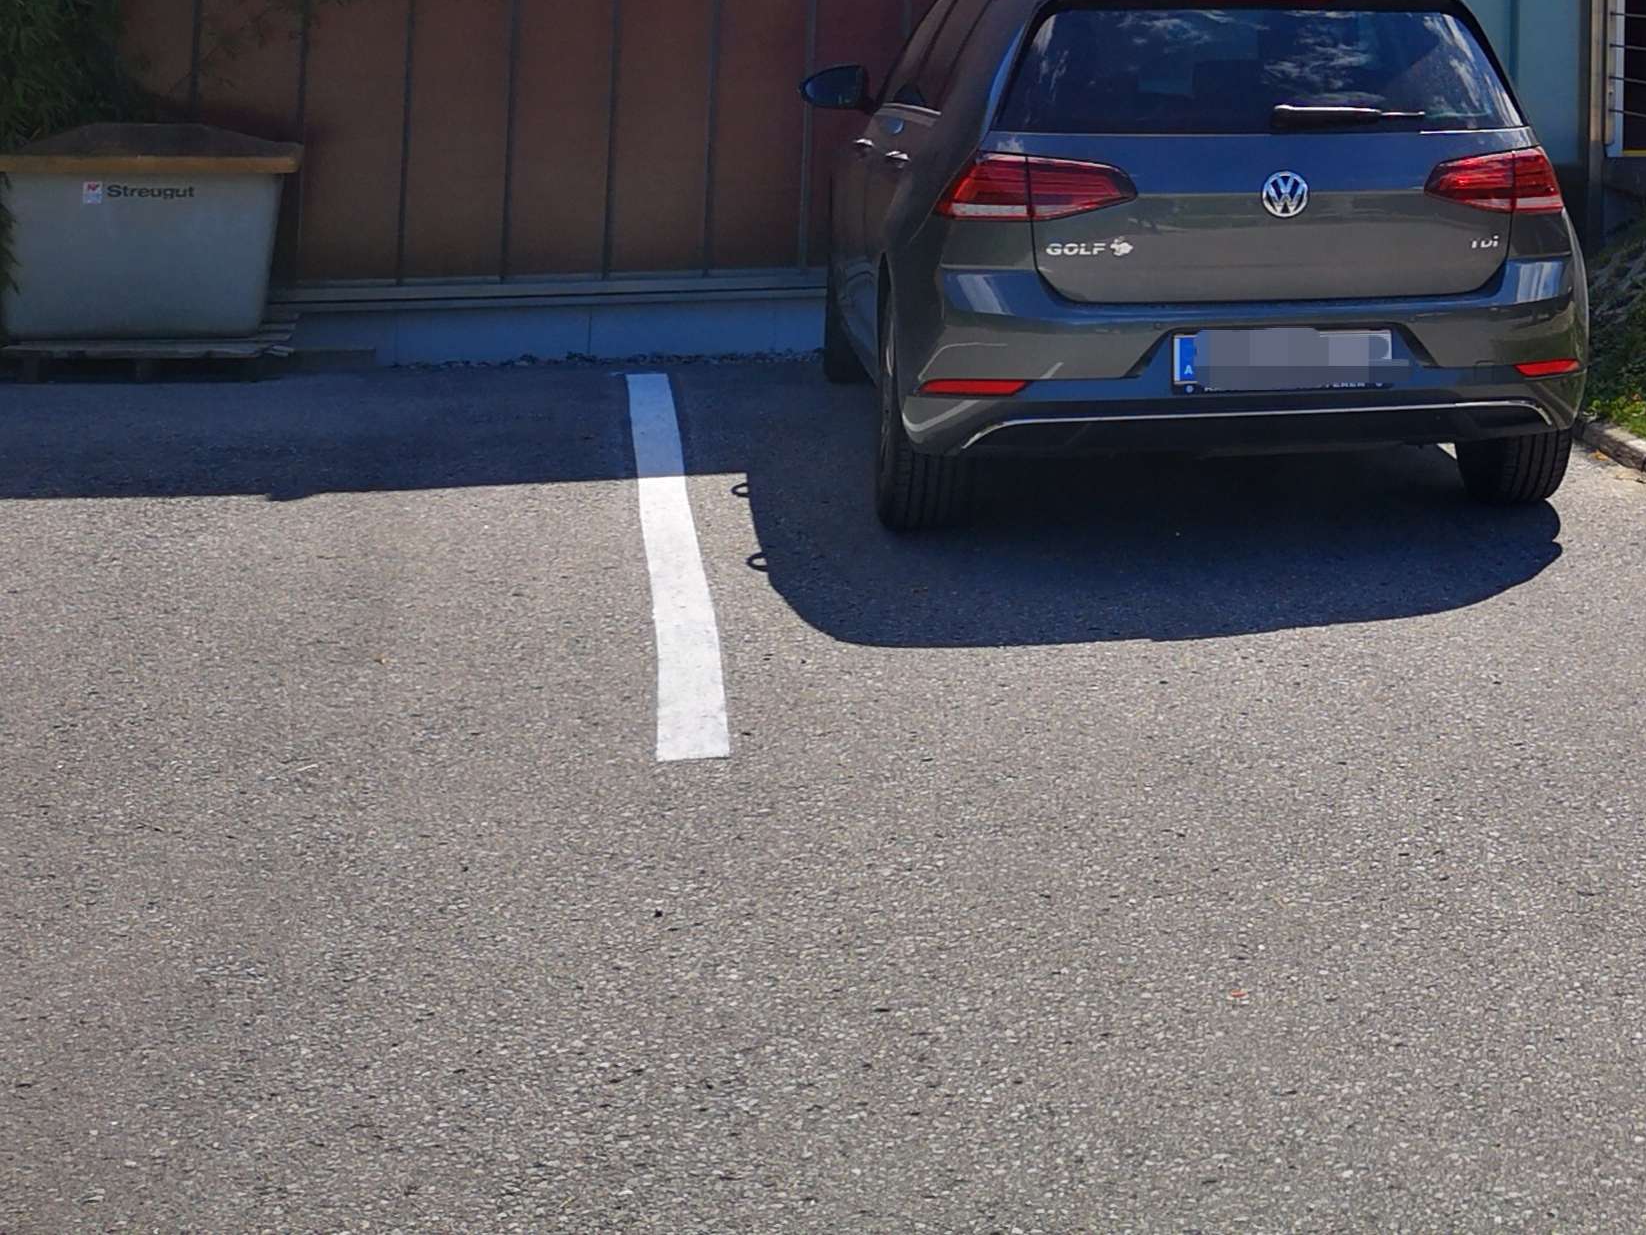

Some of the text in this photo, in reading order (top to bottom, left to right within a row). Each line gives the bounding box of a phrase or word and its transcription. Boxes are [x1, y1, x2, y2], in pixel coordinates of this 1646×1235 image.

[107, 184, 195, 200] Streugut
[1046, 243, 1106, 255] GOLF
[1184, 365, 1193, 375] A
